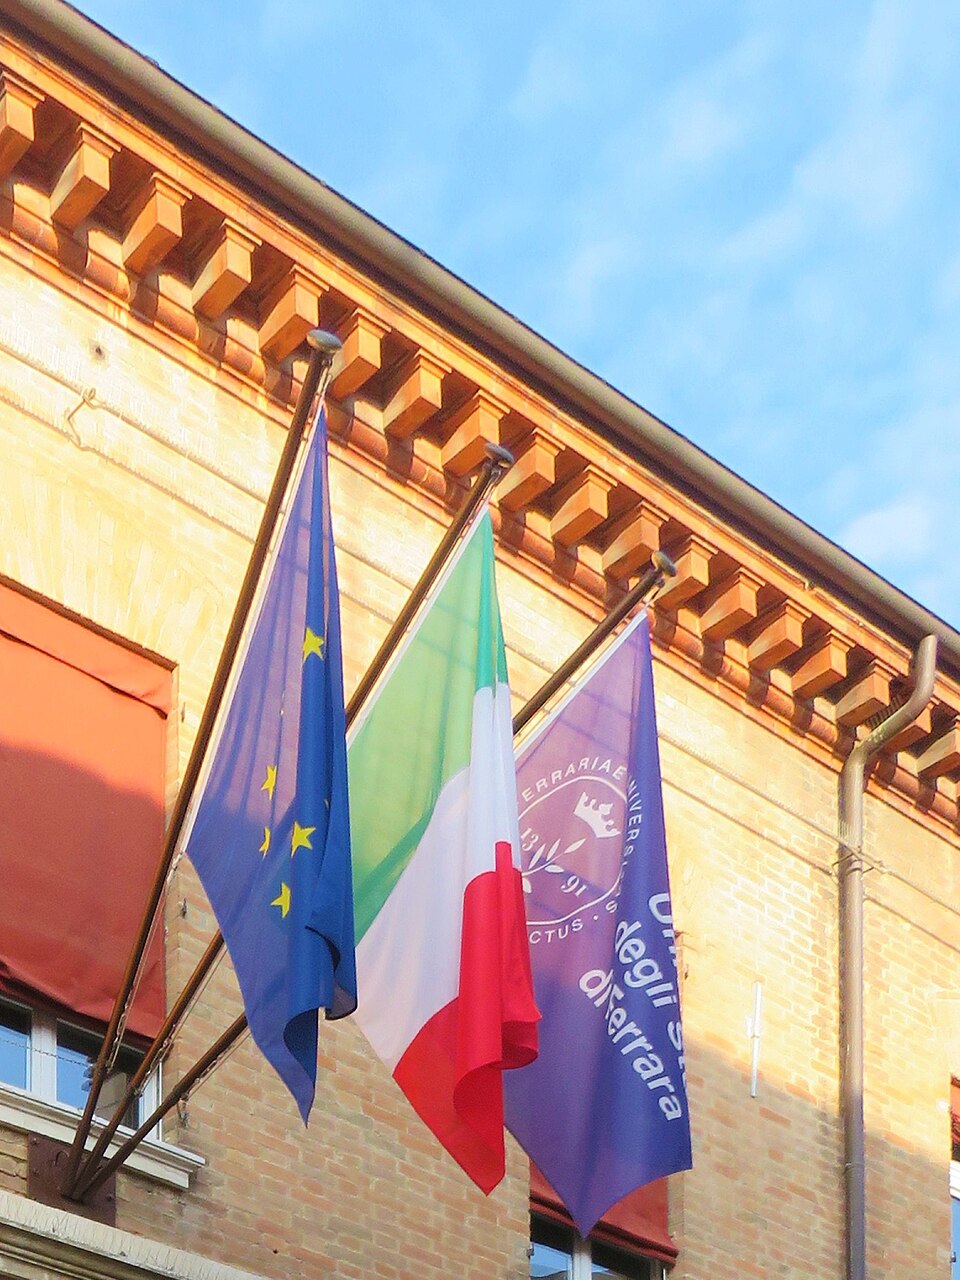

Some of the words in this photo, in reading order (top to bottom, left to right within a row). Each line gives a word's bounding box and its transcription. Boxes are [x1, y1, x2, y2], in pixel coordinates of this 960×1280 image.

[521, 756, 627, 802] ERRARIAE
[529, 918, 583, 944] CTUS
[615, 920, 677, 1008] degli
